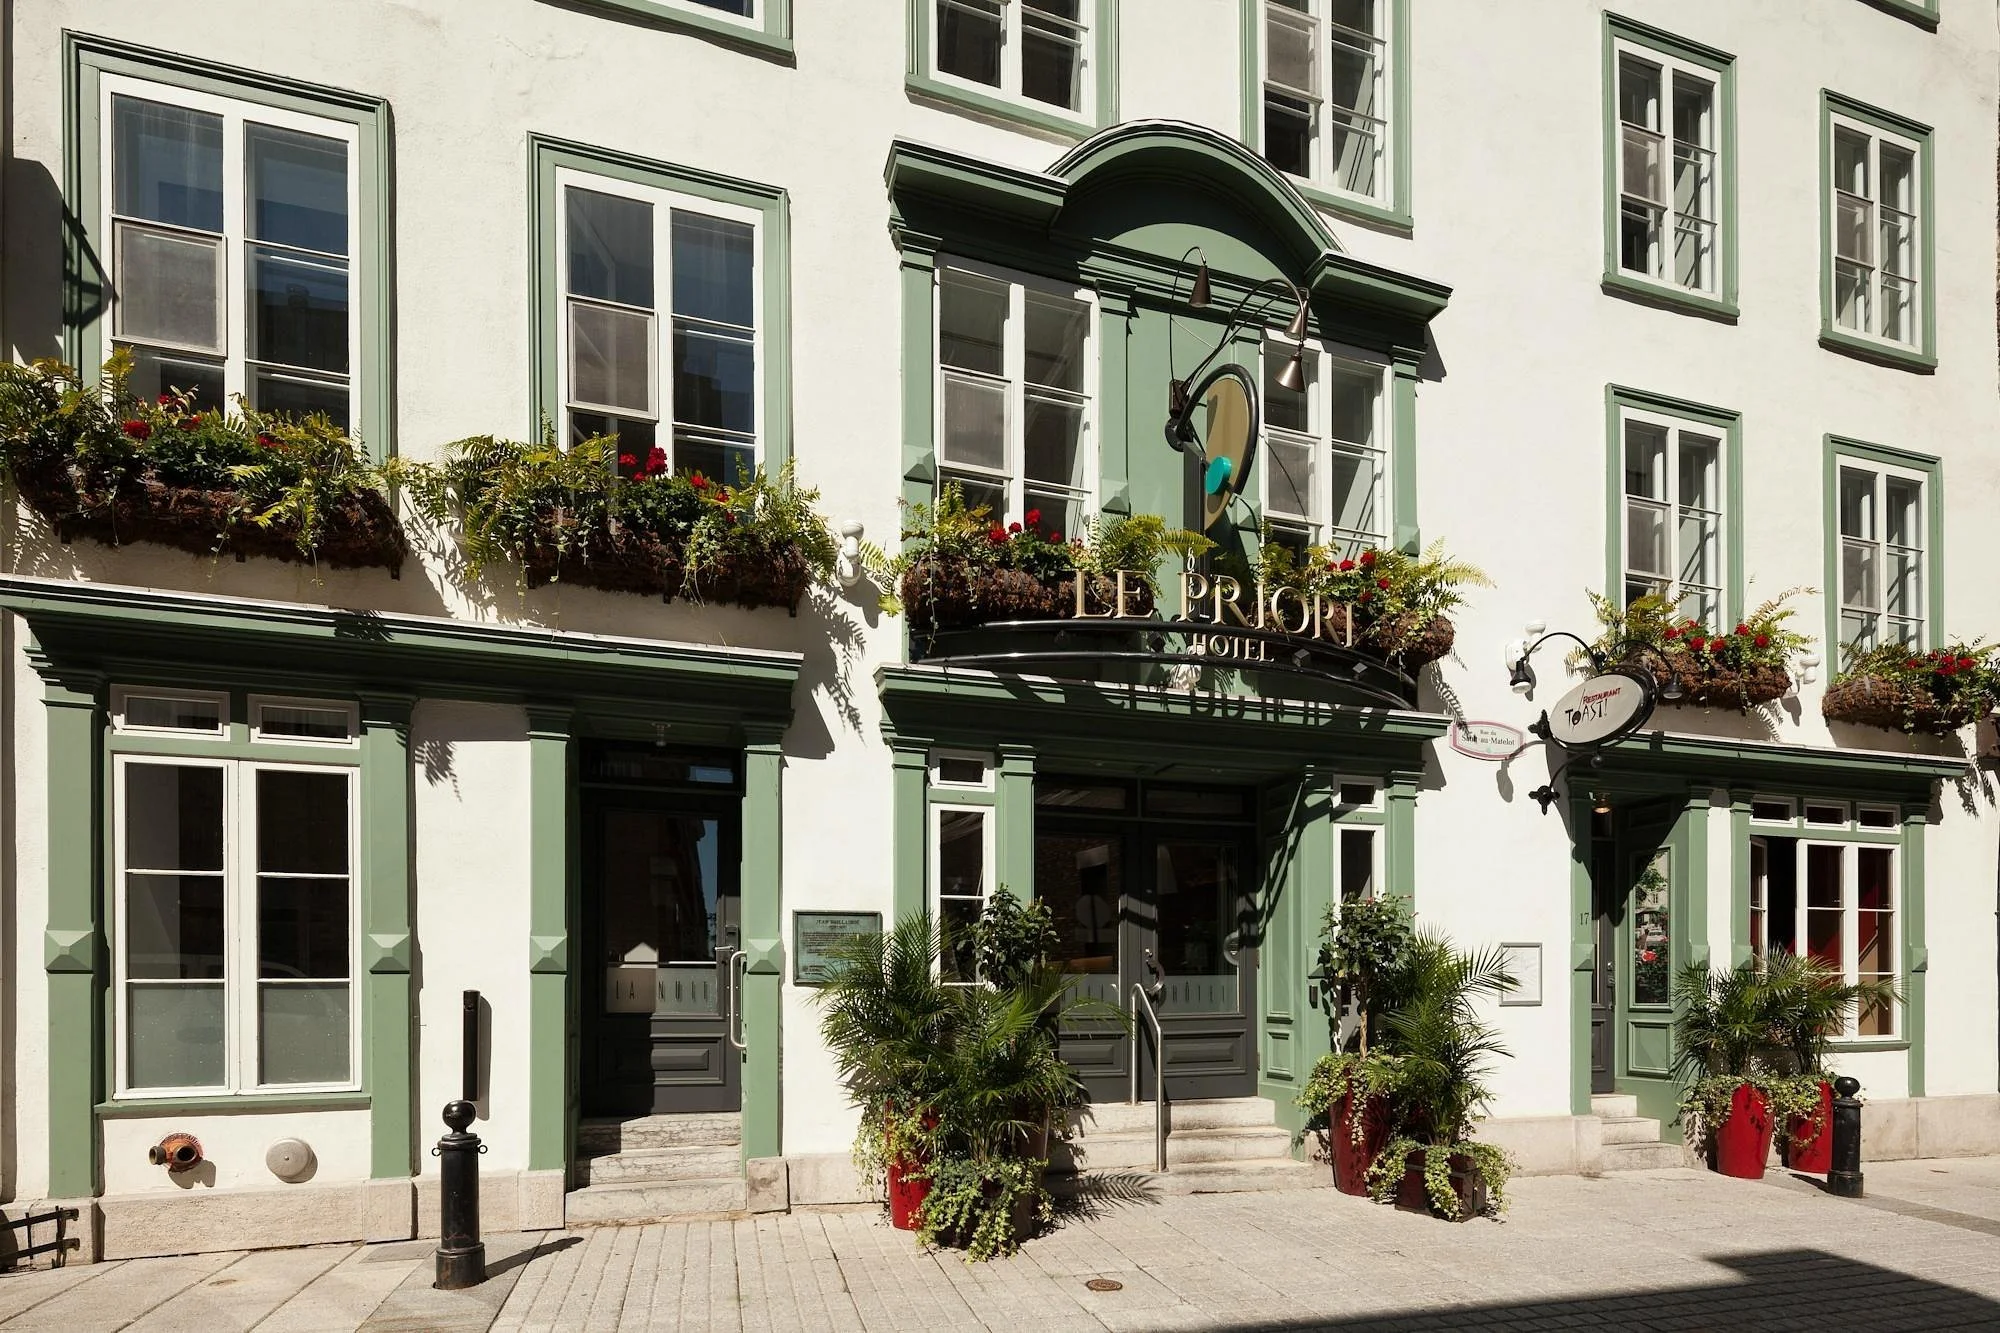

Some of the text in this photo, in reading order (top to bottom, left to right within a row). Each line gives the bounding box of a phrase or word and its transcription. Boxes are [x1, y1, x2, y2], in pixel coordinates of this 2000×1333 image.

[1072, 568, 1354, 649] LE PRIORI
[1191, 632, 1275, 663] HOTEL
[1583, 687, 1621, 704] RESTAURANT
[1565, 698, 1608, 728] TOAST!
[1580, 912, 1590, 925] 17
